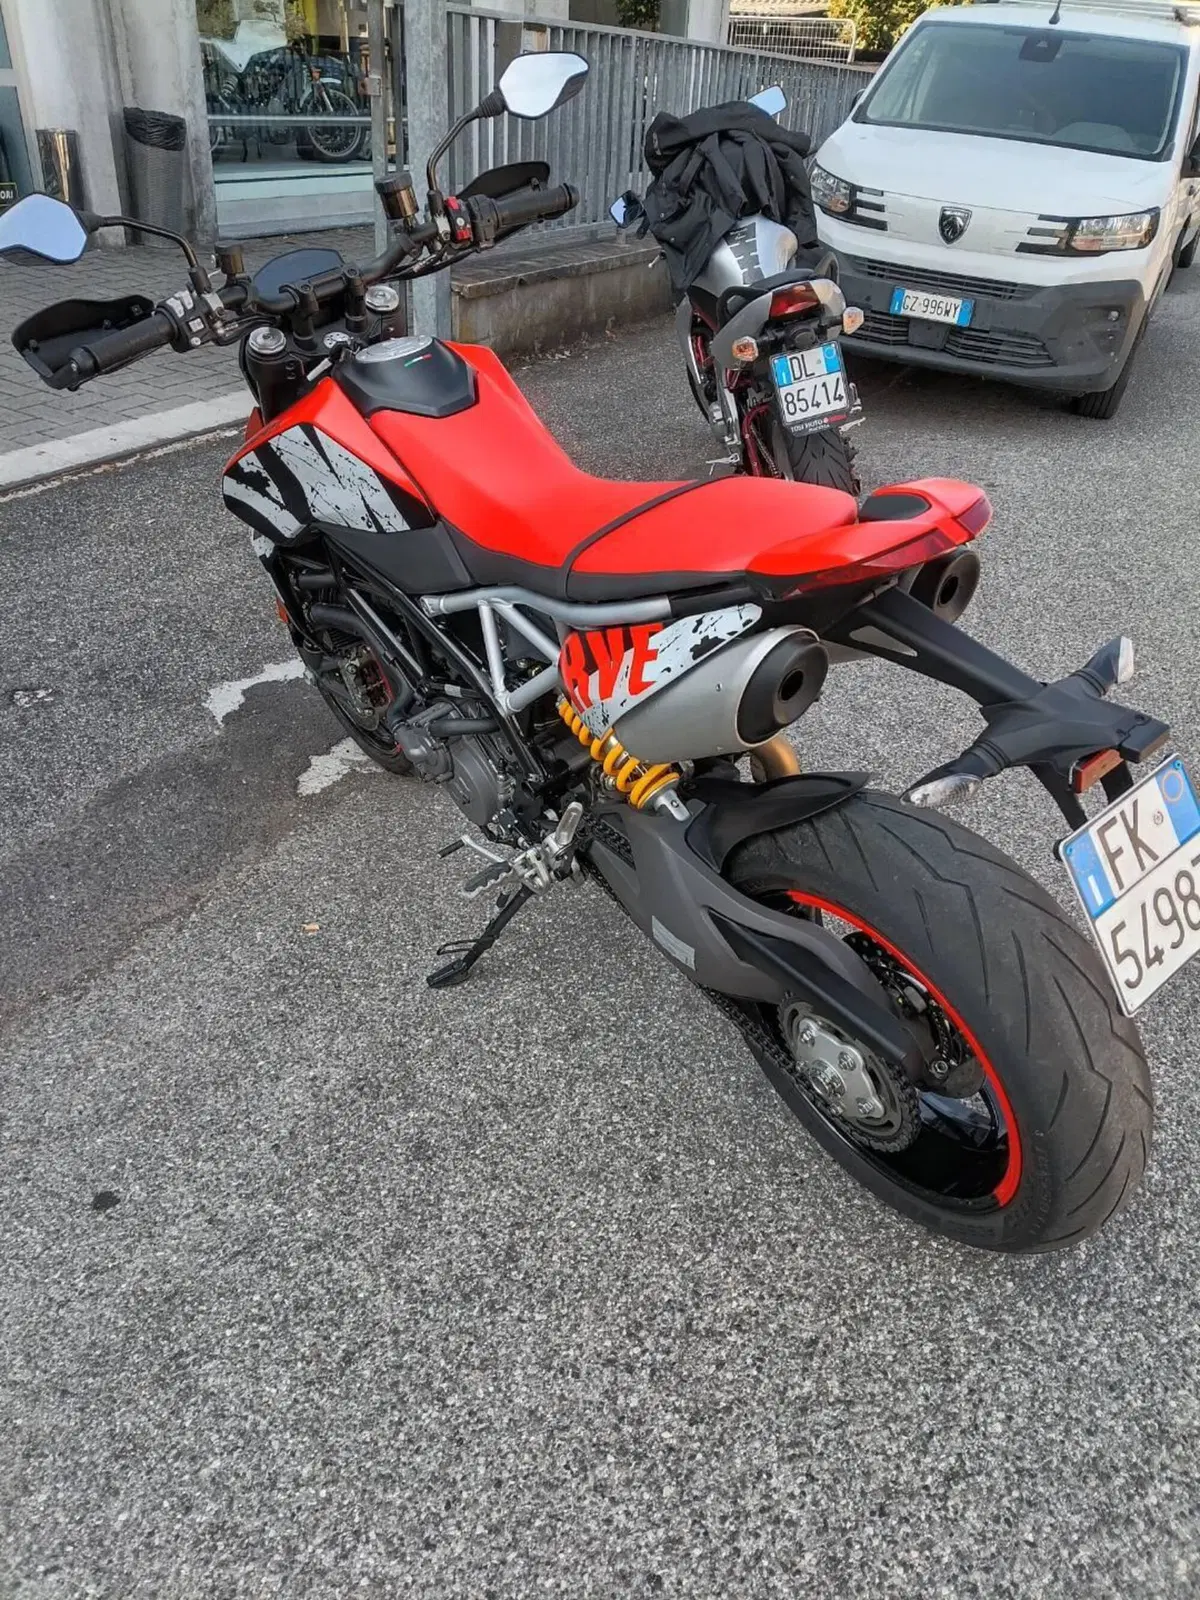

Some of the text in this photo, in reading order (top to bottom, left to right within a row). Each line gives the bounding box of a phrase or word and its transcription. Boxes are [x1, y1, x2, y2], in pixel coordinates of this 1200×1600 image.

[784, 377, 844, 416] 85414
[789, 353, 816, 381] DL
[559, 622, 665, 714] RVE
[1097, 798, 1160, 892] FK
